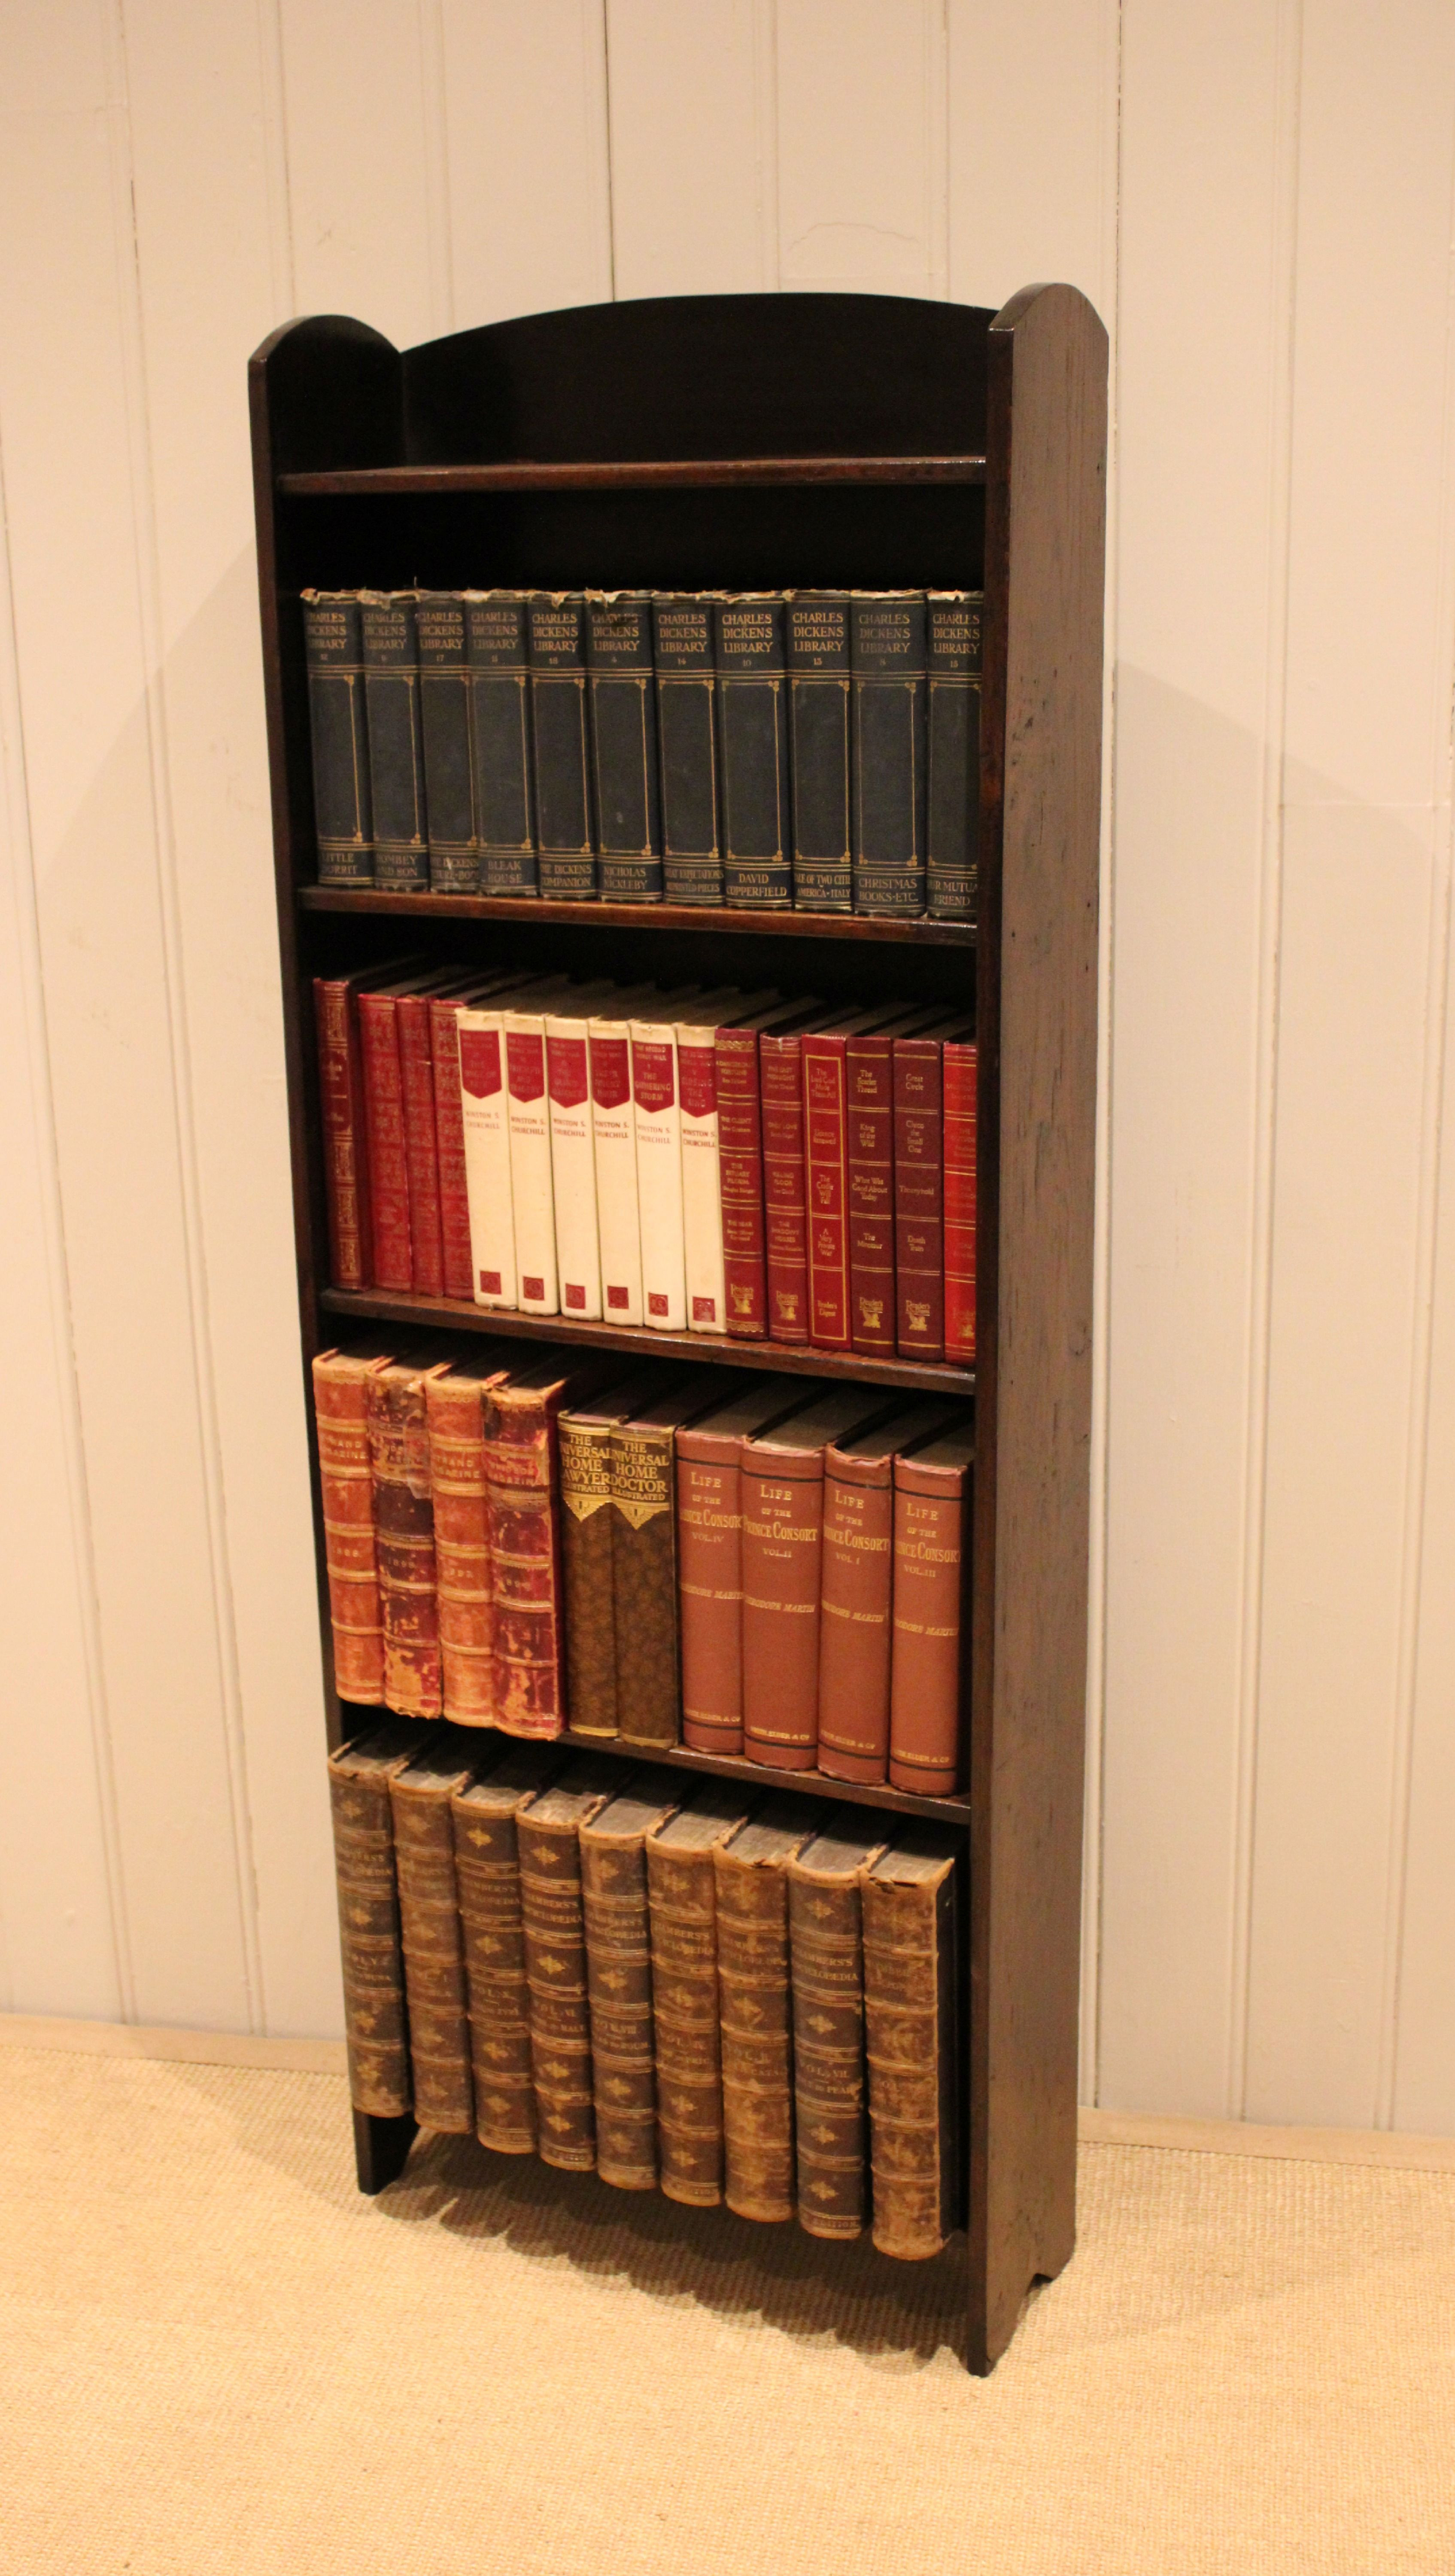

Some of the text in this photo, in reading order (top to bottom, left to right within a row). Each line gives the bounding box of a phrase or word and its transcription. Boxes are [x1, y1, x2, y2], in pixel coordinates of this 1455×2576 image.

[472, 612, 517, 622] CHARLES
[532, 614, 577, 623] CHARLES
[659, 614, 706, 624] CHARLES
[722, 614, 772, 624] CHARLES
[793, 612, 843, 623] CHARLES
[859, 614, 910, 624] CHARLES
[933, 613, 980, 624] CHARLES
[420, 625, 463, 636] DICKENS
[473, 626, 518, 636] DICKENS
[533, 627, 578, 637] DICKENS
[593, 627, 639, 637] DICKENS
[660, 627, 707, 638] DICKENS
[723, 628, 773, 638] DICKENS
[794, 627, 844, 637] DICKENS
[860, 628, 911, 639] DICKENS
[933, 628, 980, 639] DICKENS
[421, 639, 464, 649] LIBRARY
[474, 639, 518, 649] LIBRARY
[534, 640, 578, 651] LIBRARY
[595, 640, 640, 651] LIBRARY
[661, 642, 708, 652] LIBRARY
[724, 642, 773, 653] LIBRARY
[795, 641, 844, 651] LIBRARY
[861, 643, 911, 654] LIBRARY
[934, 643, 980, 654] LIBRARY
[488, 861, 522, 871] BLEAK
[554, 864, 592, 874] DICKENS
[603, 866, 646, 877] NICHOLAS
[488, 873, 522, 884] HOUSE
[739, 873, 769, 884] DAVID
[817, 875, 832, 885] TWO
[859, 879, 917, 889] CHRISTMAS
[726, 886, 787, 897] COPPERFIELD
[934, 895, 970, 906] FRIEND
[860, 1069, 872, 1077] The
[906, 1073, 923, 1082] Great
[905, 1082, 923, 1091] Circle
[641, 1092, 663, 1101] STORM
[512, 1126, 544, 1135] CHURCHILL
[637, 1125, 662, 1133] WINSTON
[683, 1128, 708, 1137] WINSTON
[595, 1130, 628, 1139] CHURCHILL
[638, 1134, 669, 1144] CHURCHILL
[683, 1139, 716, 1148] CHURCHILL
[863, 1232, 876, 1241] The
[570, 1434, 592, 1446] THE
[623, 1441, 647, 1453] THE
[562, 1457, 602, 1472] HOME
[616, 1462, 657, 1479] HOME
[610, 1473, 668, 1493] DOCTOR
[691, 1472, 721, 1488] LIFE
[564, 1482, 610, 1493] USTRATED
[760, 1484, 792, 1501] LIFE
[612, 1487, 665, 1501] ILLUSTRATED
[704, 1496, 721, 1505] THE
[835, 1490, 864, 1509] LIFE
[774, 1509, 792, 1518] THE
[906, 1502, 939, 1521] LIFE
[846, 1516, 863, 1526] THE
[773, 1521, 818, 1542] CONSORT
[919, 1528, 937, 1538] THE
[844, 1529, 890, 1551] CONSORT
[917, 1542, 960, 1563] CONSOR
